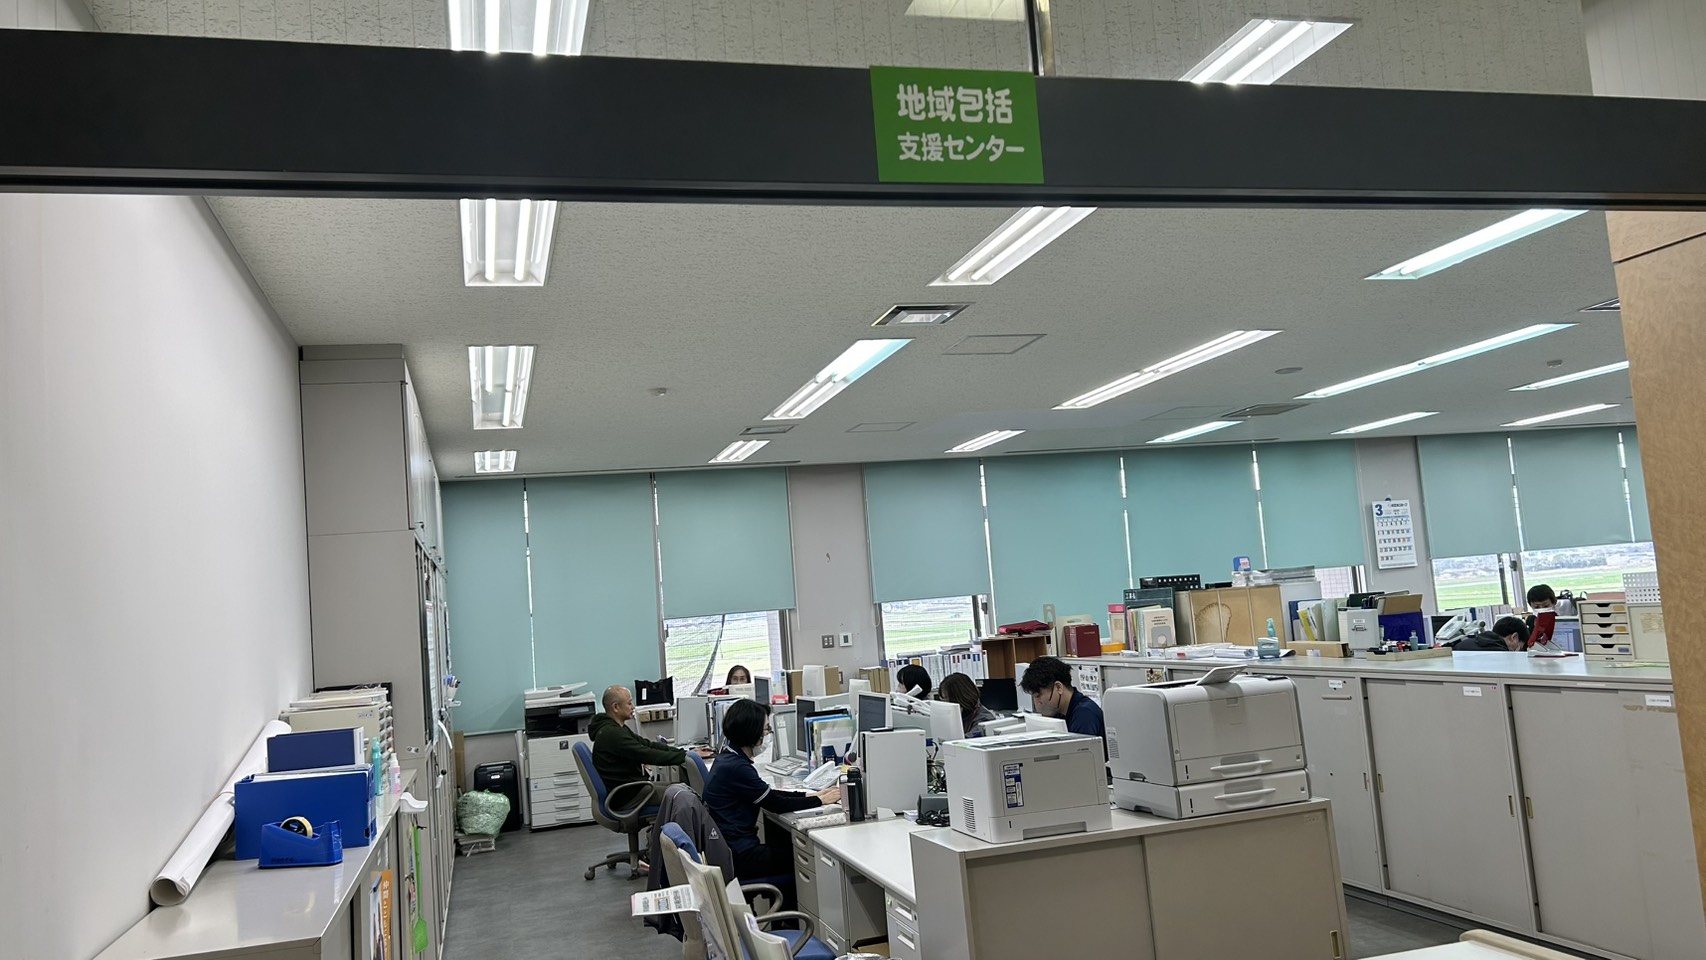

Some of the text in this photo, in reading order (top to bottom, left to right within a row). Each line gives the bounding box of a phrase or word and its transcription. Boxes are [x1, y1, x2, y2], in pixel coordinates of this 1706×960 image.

[897, 83, 1013, 124] 地域包括
[897, 132, 1025, 162] 支援センター
[1375, 504, 1383, 516] 3
